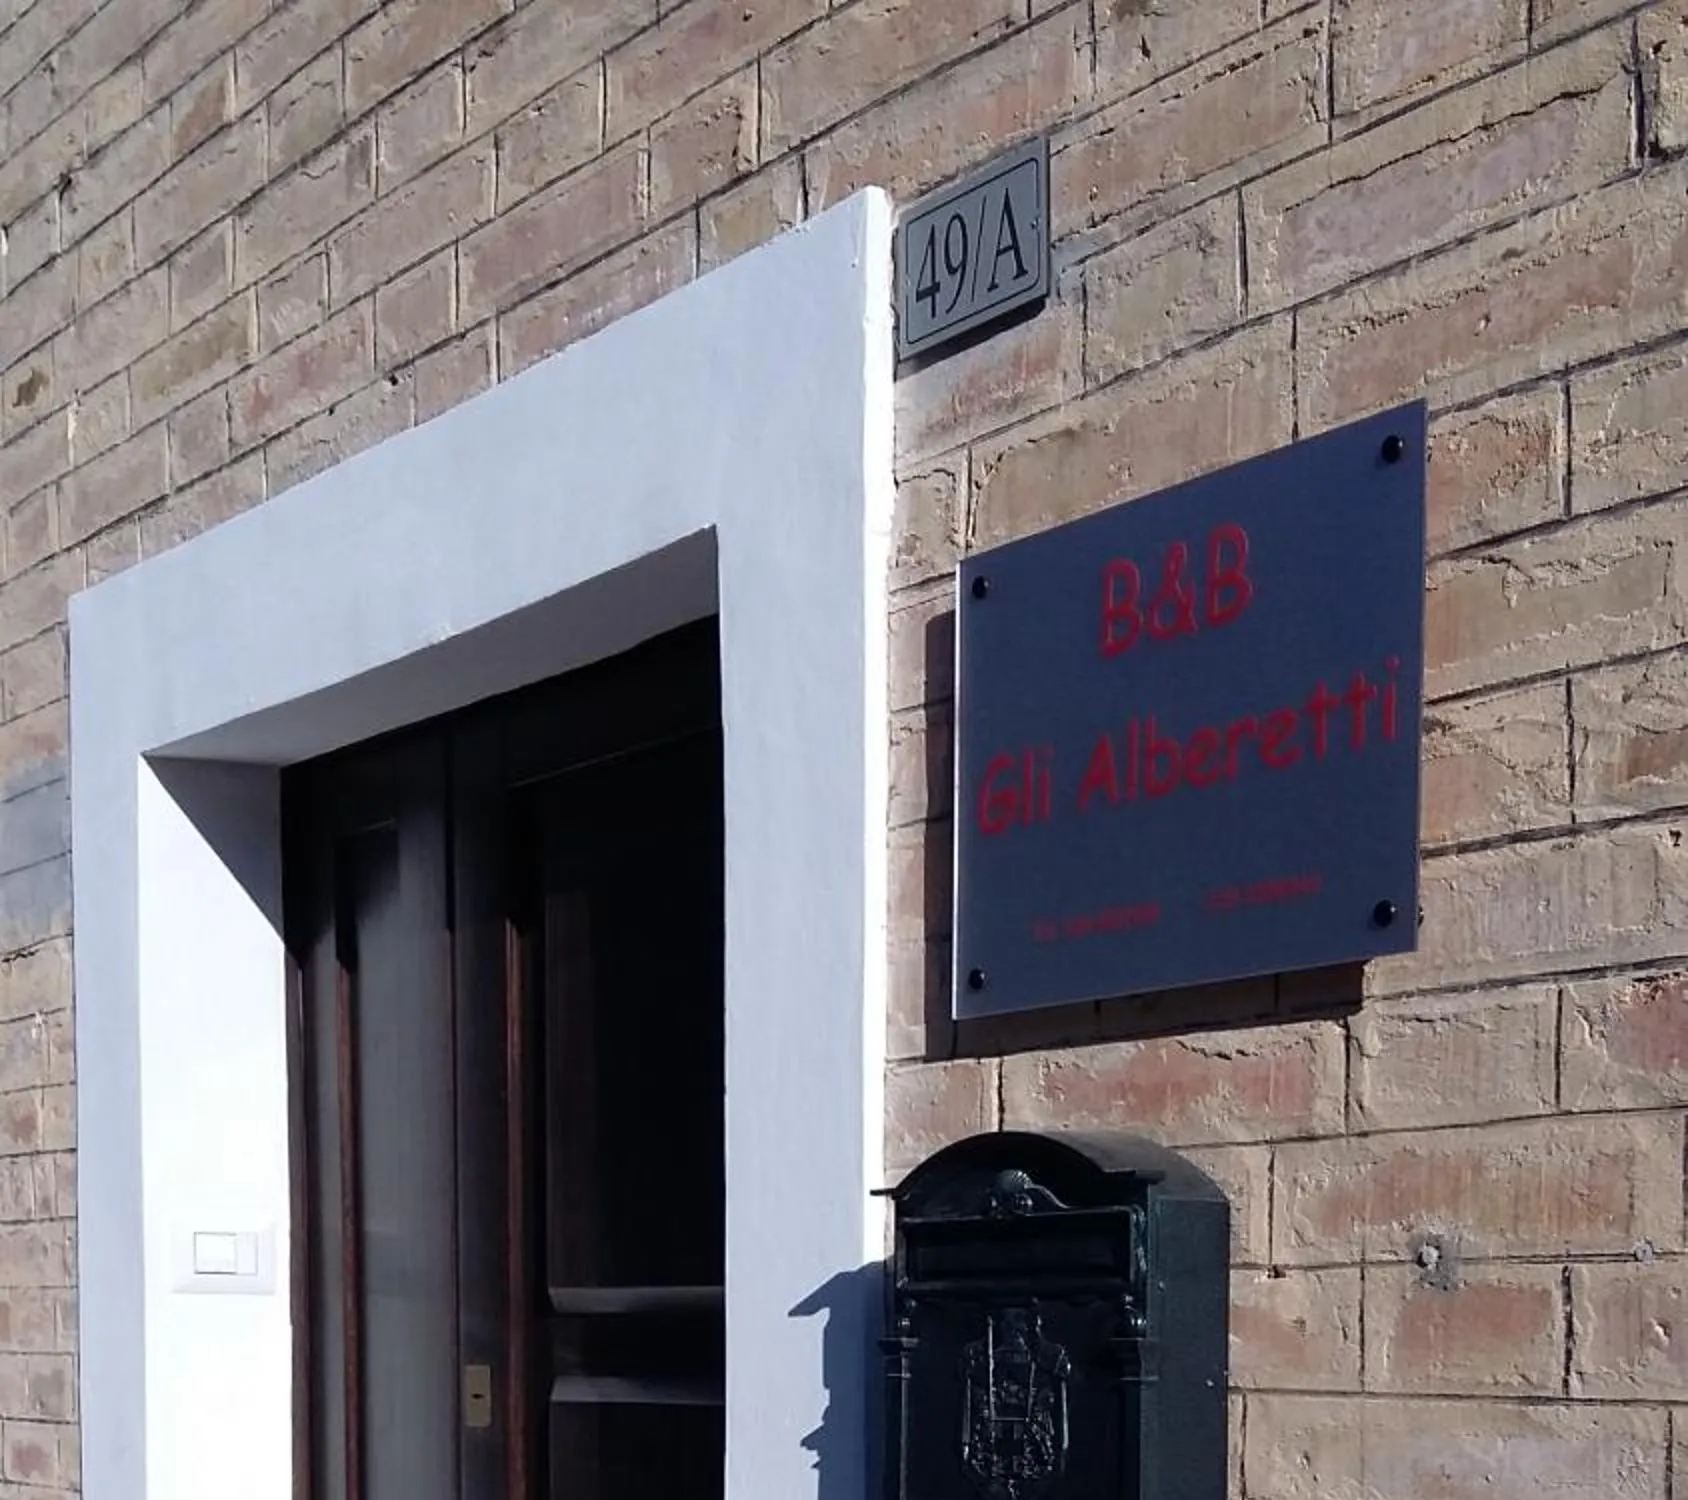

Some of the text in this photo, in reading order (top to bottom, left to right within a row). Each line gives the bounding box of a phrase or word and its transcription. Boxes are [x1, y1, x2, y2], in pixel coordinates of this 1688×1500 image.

[915, 187, 1029, 320] 49/A
[1099, 523, 1253, 659] B&B
[977, 656, 1402, 837] Gli Alberetti
